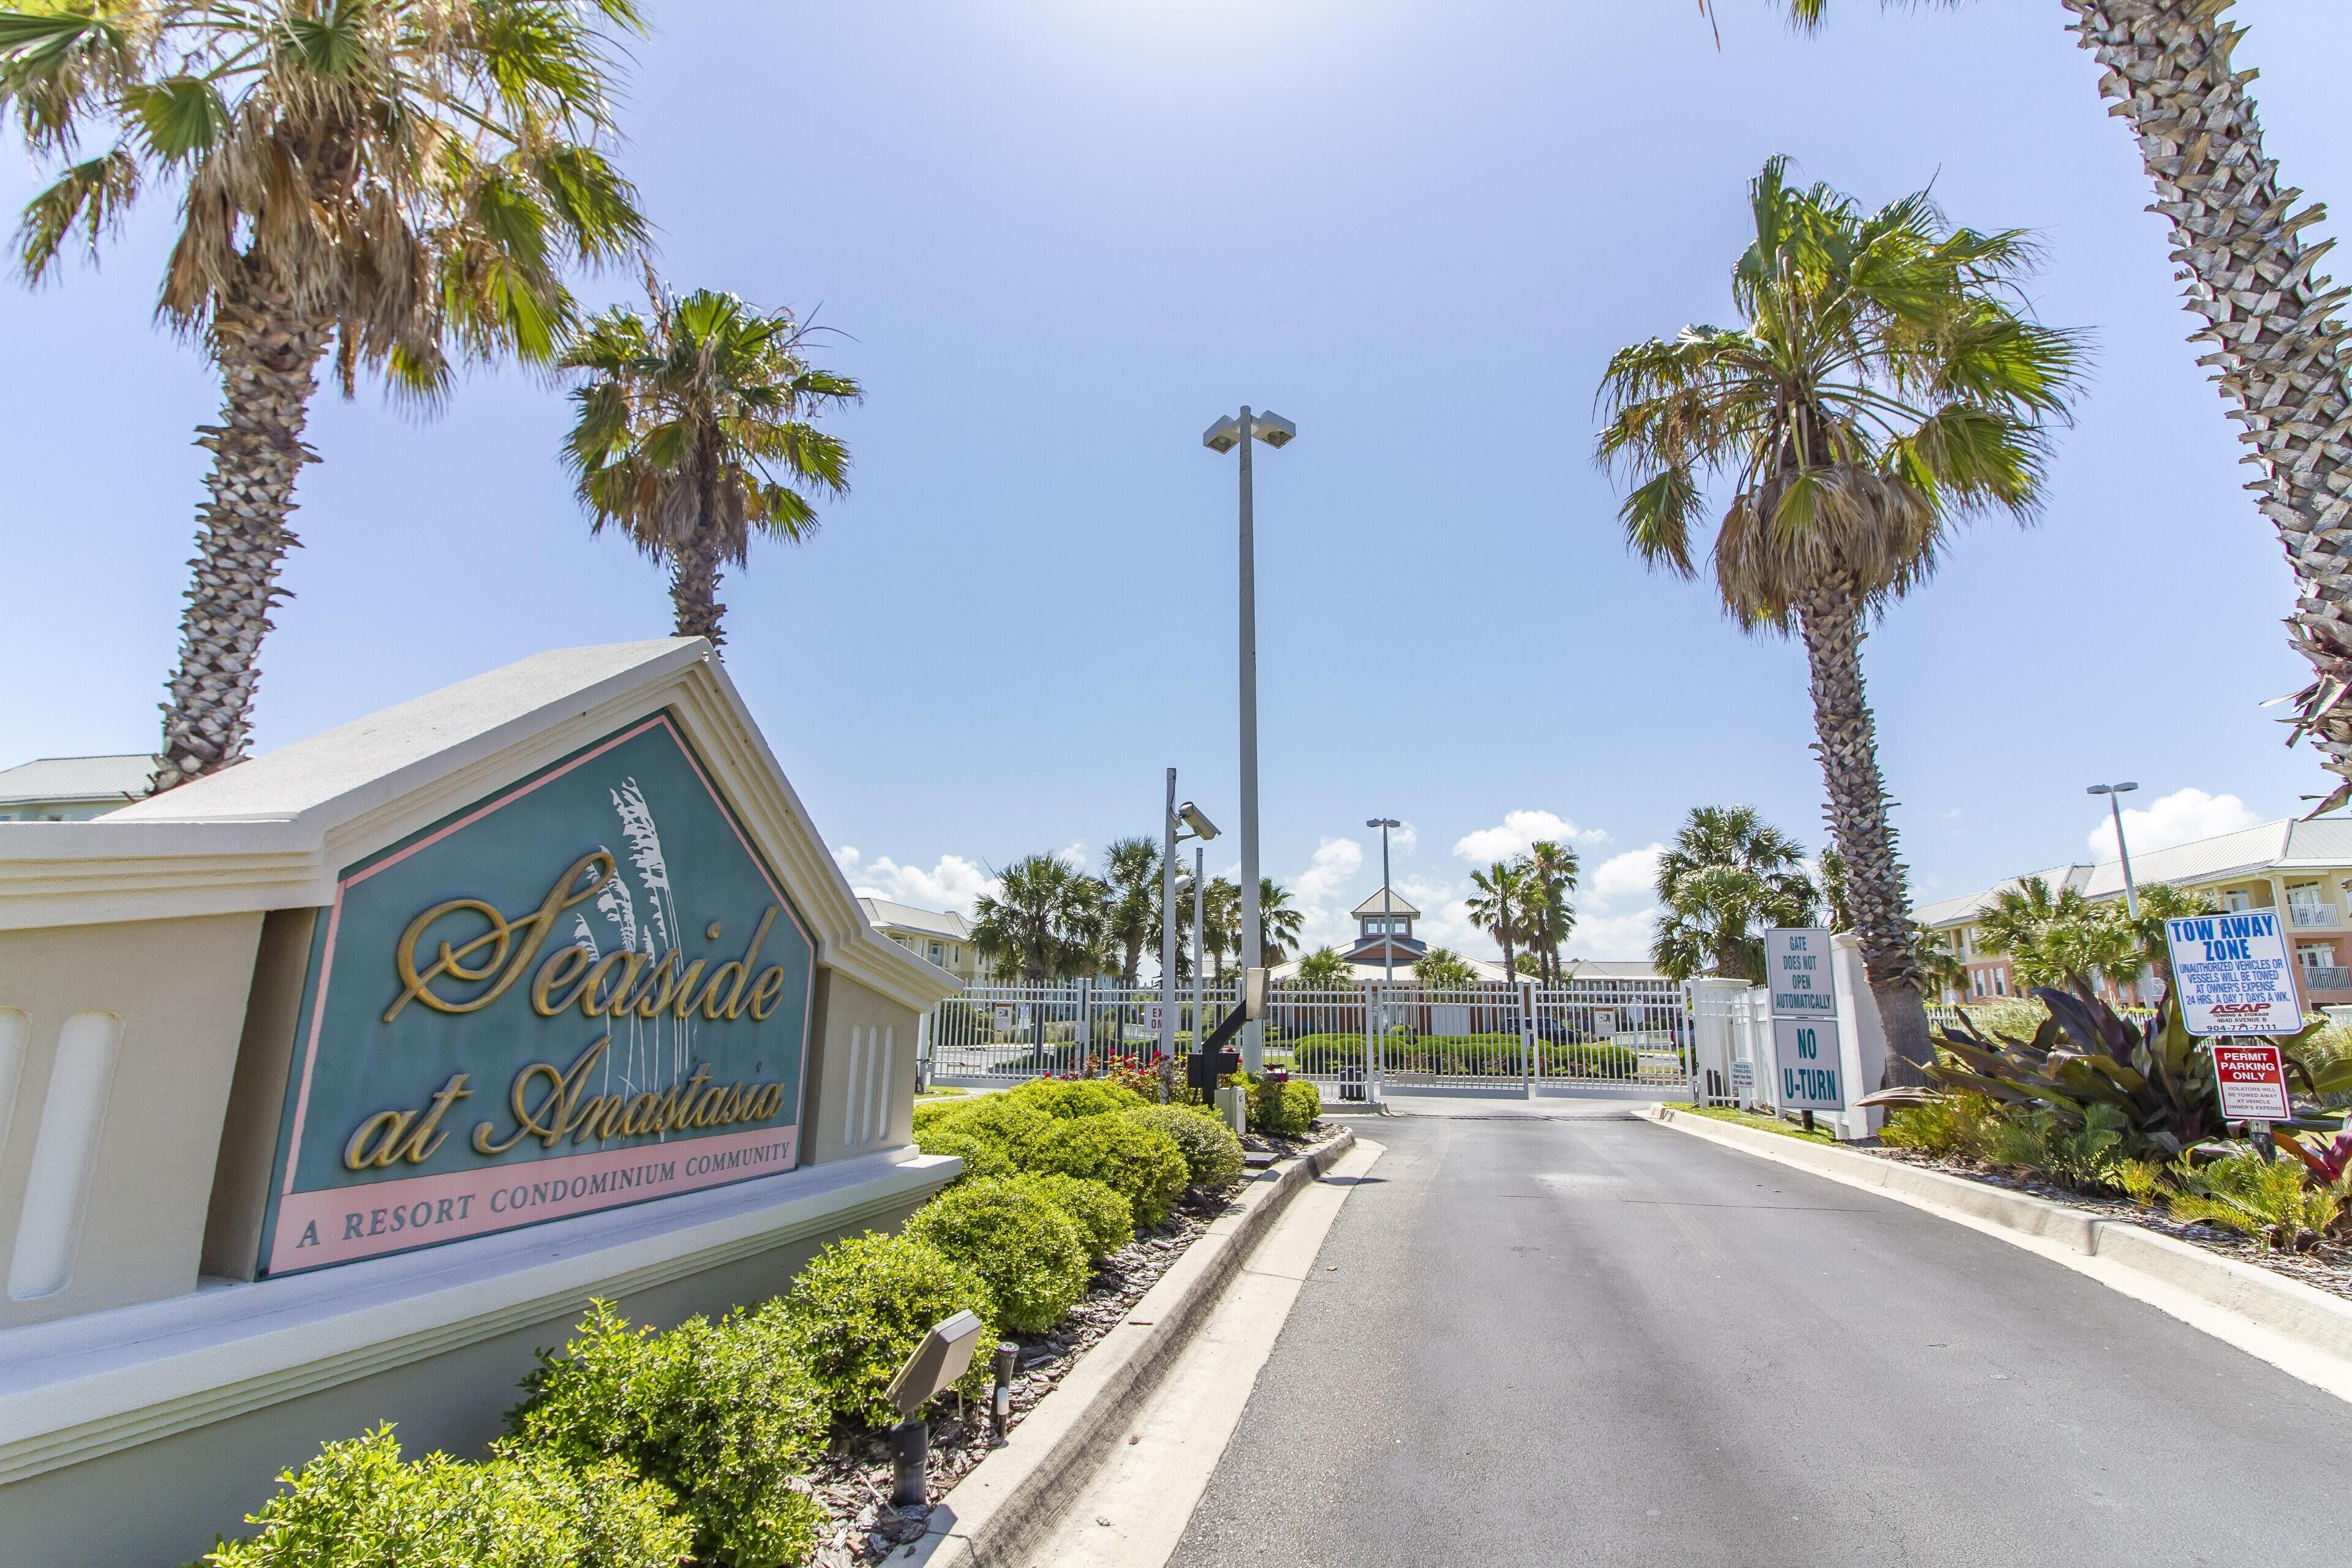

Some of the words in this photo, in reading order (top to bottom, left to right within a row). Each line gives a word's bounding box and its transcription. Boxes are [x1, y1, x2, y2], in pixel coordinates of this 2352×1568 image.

[384, 851, 784, 1022] Seaside
[2171, 920, 2214, 942] TOW
[2220, 916, 2273, 939] AWAY
[1790, 937, 1807, 951] GATE
[2203, 939, 2251, 961] ZONE
[1783, 956, 1801, 970] DOES
[1803, 956, 1817, 970] NOT
[2179, 962, 2233, 973] UNAUTHORIZED
[2236, 960, 2271, 970] VEHICLES
[2272, 959, 2283, 969] OR
[1792, 974, 1811, 989] OPEN
[2187, 973, 2219, 983] VESSELS
[2221, 972, 2239, 982] WILL
[2241, 971, 2251, 981] BE
[2252, 970, 2278, 980] TOWED
[2196, 984, 2204, 993] AT
[2207, 982, 2240, 993] OWNER'S
[2242, 981, 2275, 992] EXPENSE
[1776, 993, 1831, 1009] AUTOMATICALLY
[2186, 995, 2195, 1005] 24
[2198, 995, 2214, 1004] HRS.
[2216, 994, 2222, 1003] A
[2223, 993, 2236, 1003] DAY
[2239, 993, 2244, 1003] 7
[2246, 993, 2266, 1003] DAYS
[2268, 992, 2273, 1002] A
[2275, 992, 2290, 1001] WK.
[2209, 1003, 2271, 1014] ASAP
[1796, 1028, 1817, 1060] NO
[2220, 1062, 2275, 1071] PARKING
[1784, 1068, 1837, 1101] U-TURN
[344, 1073, 474, 1170] at
[472, 1035, 786, 1154] Anastasia
[295, 1219, 321, 1248] A
[342, 1194, 475, 1240] RESORT
[490, 1161, 676, 1213] CONDOMINIUM
[686, 1142, 791, 1175] COMMUNITY
